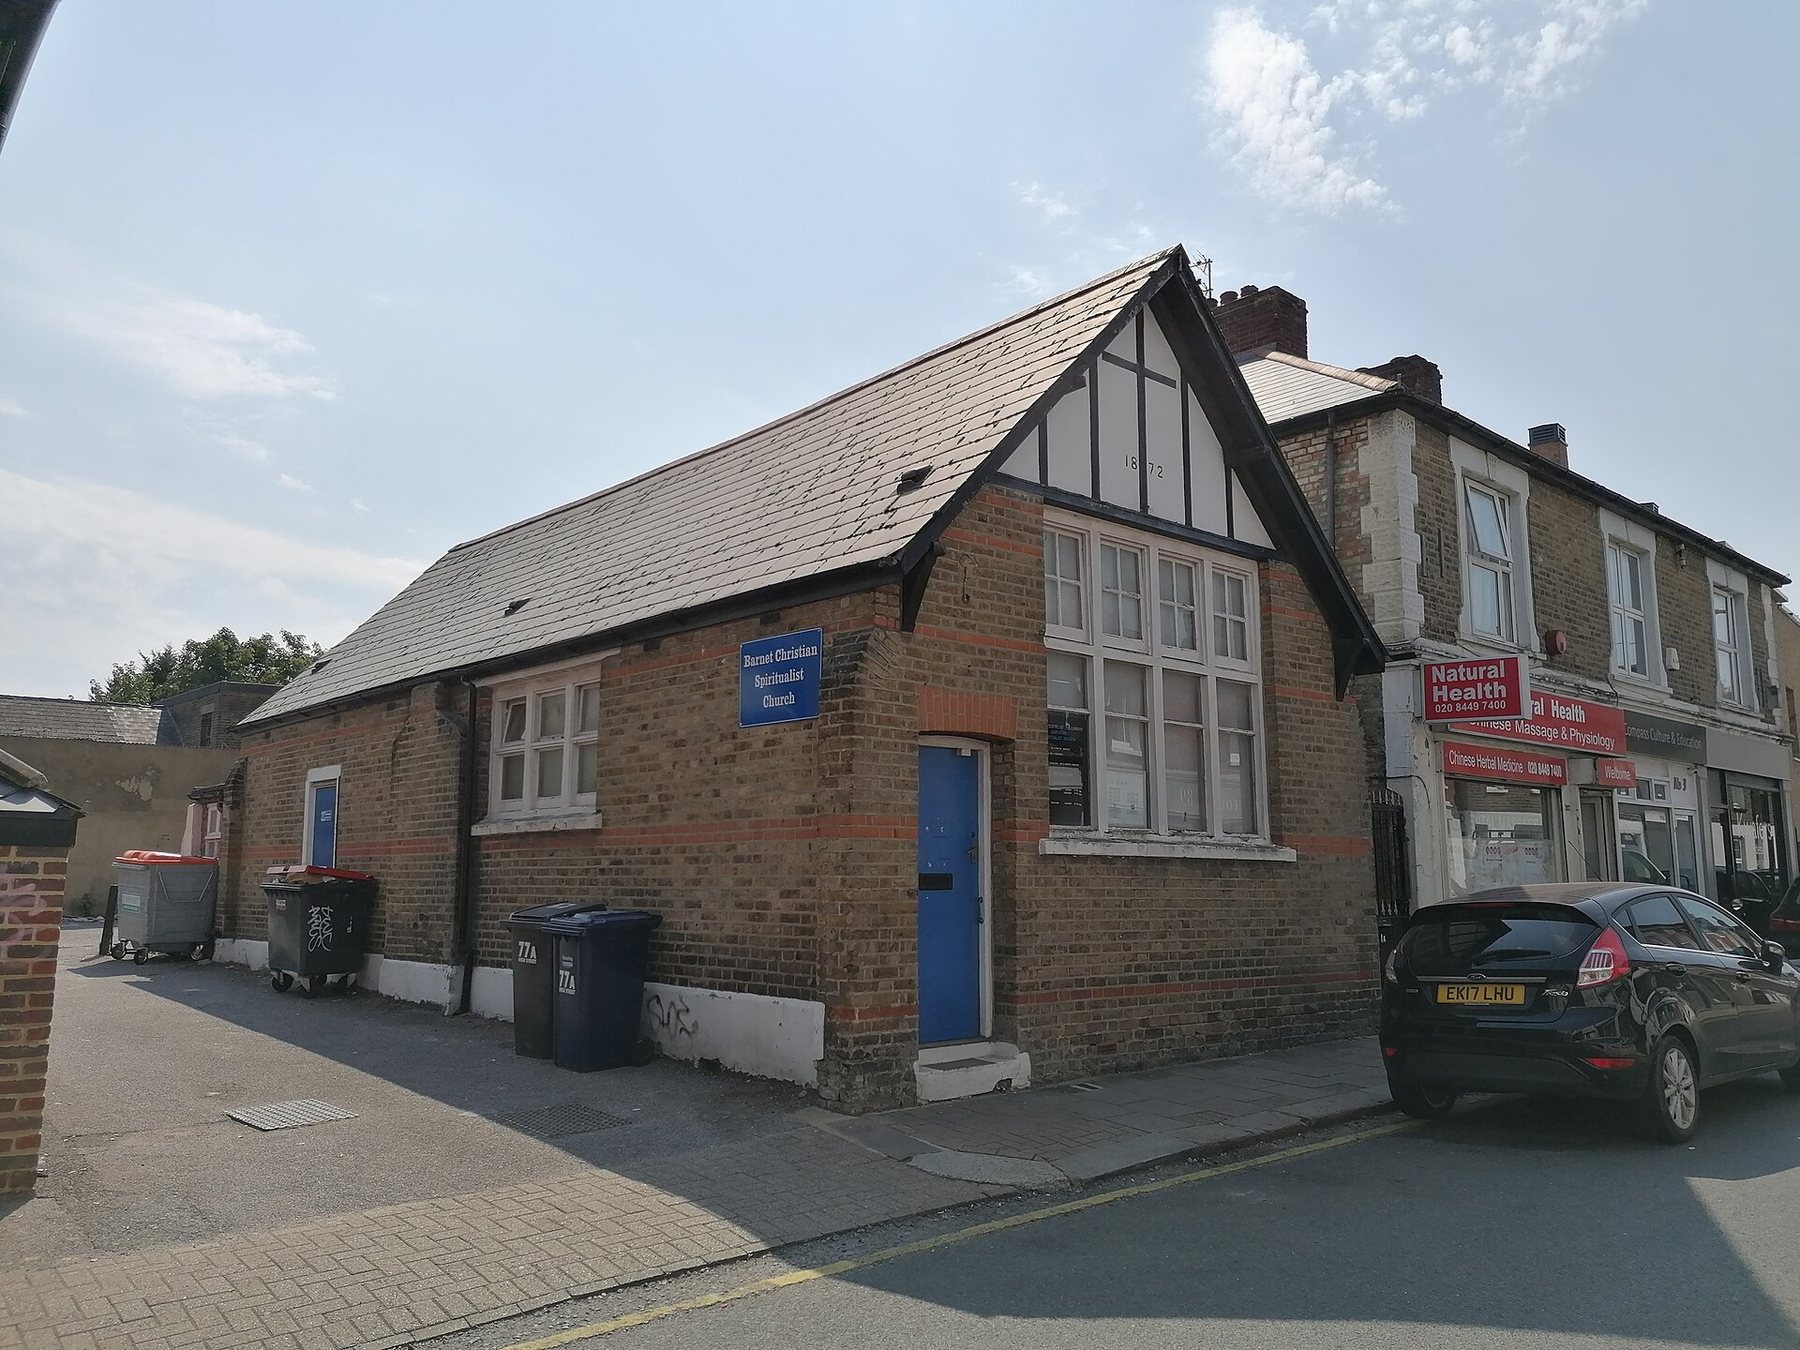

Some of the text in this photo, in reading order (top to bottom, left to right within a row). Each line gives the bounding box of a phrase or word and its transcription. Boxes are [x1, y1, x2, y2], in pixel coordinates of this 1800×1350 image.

[743, 644, 818, 668] Barnet Christian
[754, 667, 805, 689] Spiritualist
[1431, 660, 1505, 683] Natural
[763, 691, 796, 708] Church
[1432, 681, 1507, 702] Health
[1435, 700, 1506, 713] 020 8449 7400
[1551, 699, 1586, 723] Health
[1515, 719, 1559, 741] Massage
[1561, 726, 1568, 740] &
[1569, 727, 1615, 751] Physiology
[1449, 749, 1476, 768] Chinese
[1476, 754, 1497, 769] Herbal
[1497, 756, 1524, 774] Medicine
[1604, 765, 1631, 781] Welcome
[519, 941, 537, 959] 77A
[559, 970, 576, 990] 77A
[1446, 986, 1514, 1001] EK17 LHU
